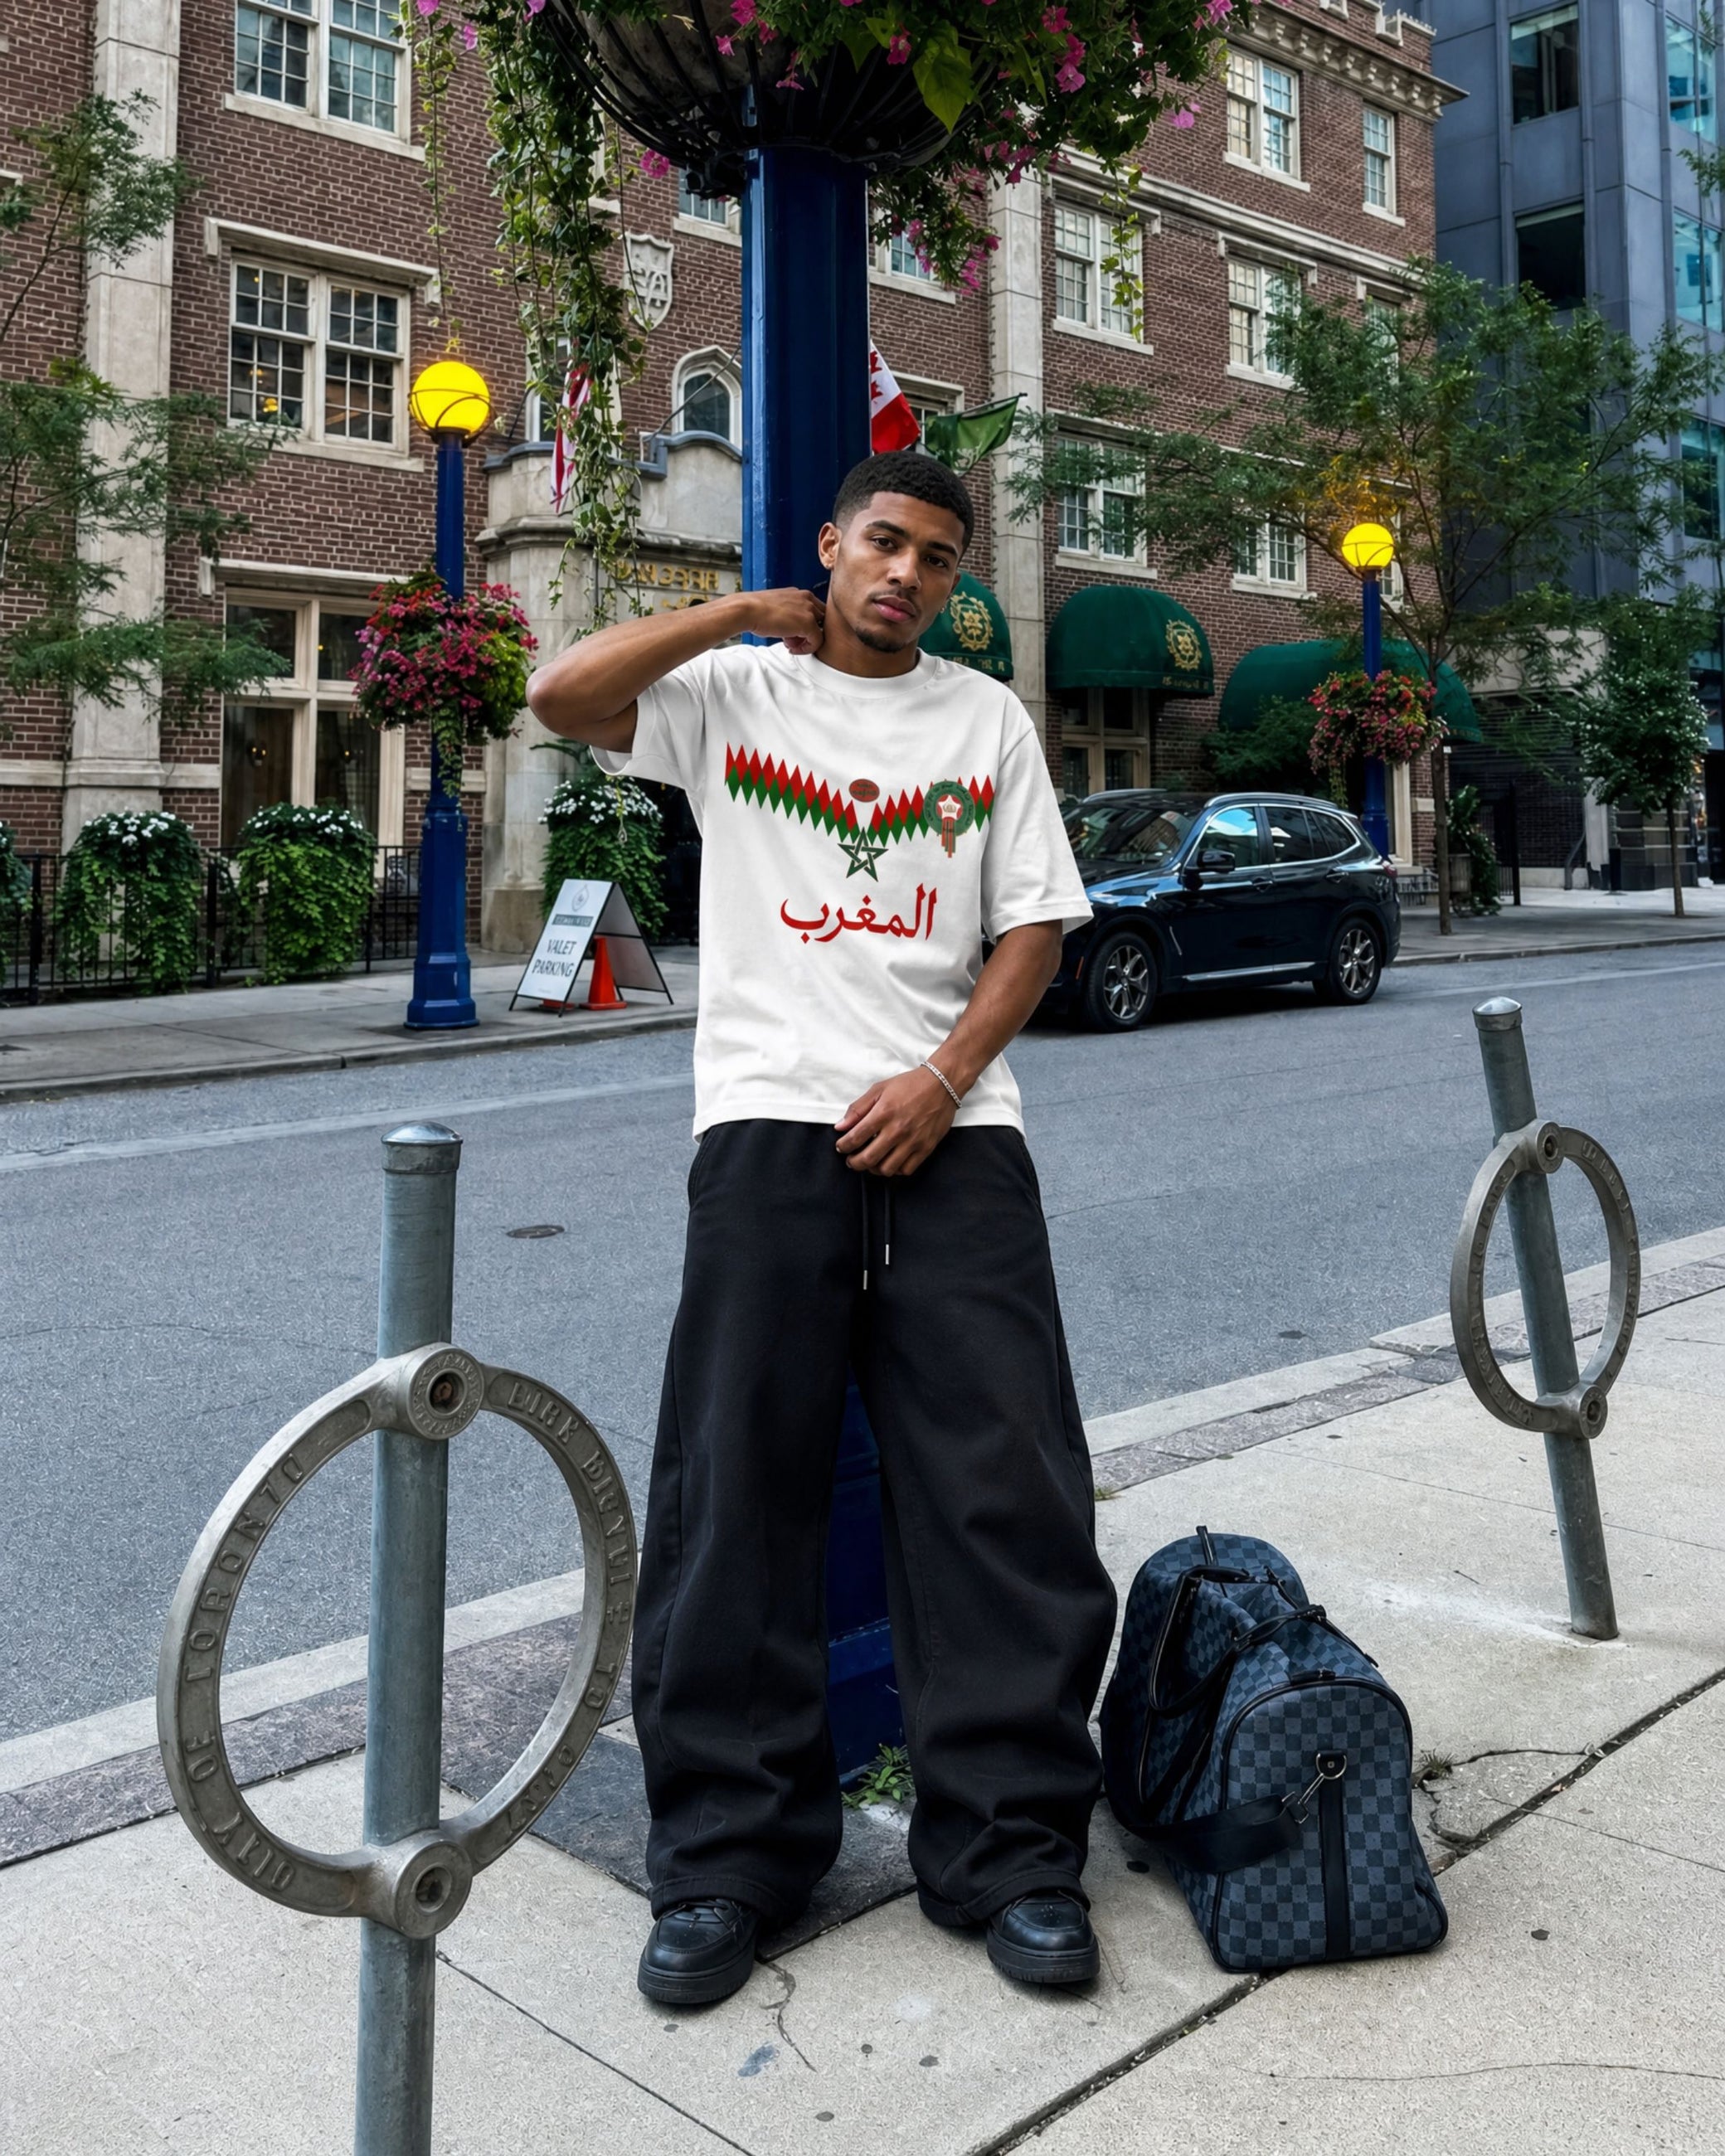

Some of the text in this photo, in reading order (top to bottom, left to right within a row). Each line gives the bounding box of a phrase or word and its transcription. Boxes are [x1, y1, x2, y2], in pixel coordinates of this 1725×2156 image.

[780, 883, 937, 944] المغرب
[547, 939, 577, 955] VALET
[532, 959, 575, 978] PARKING
